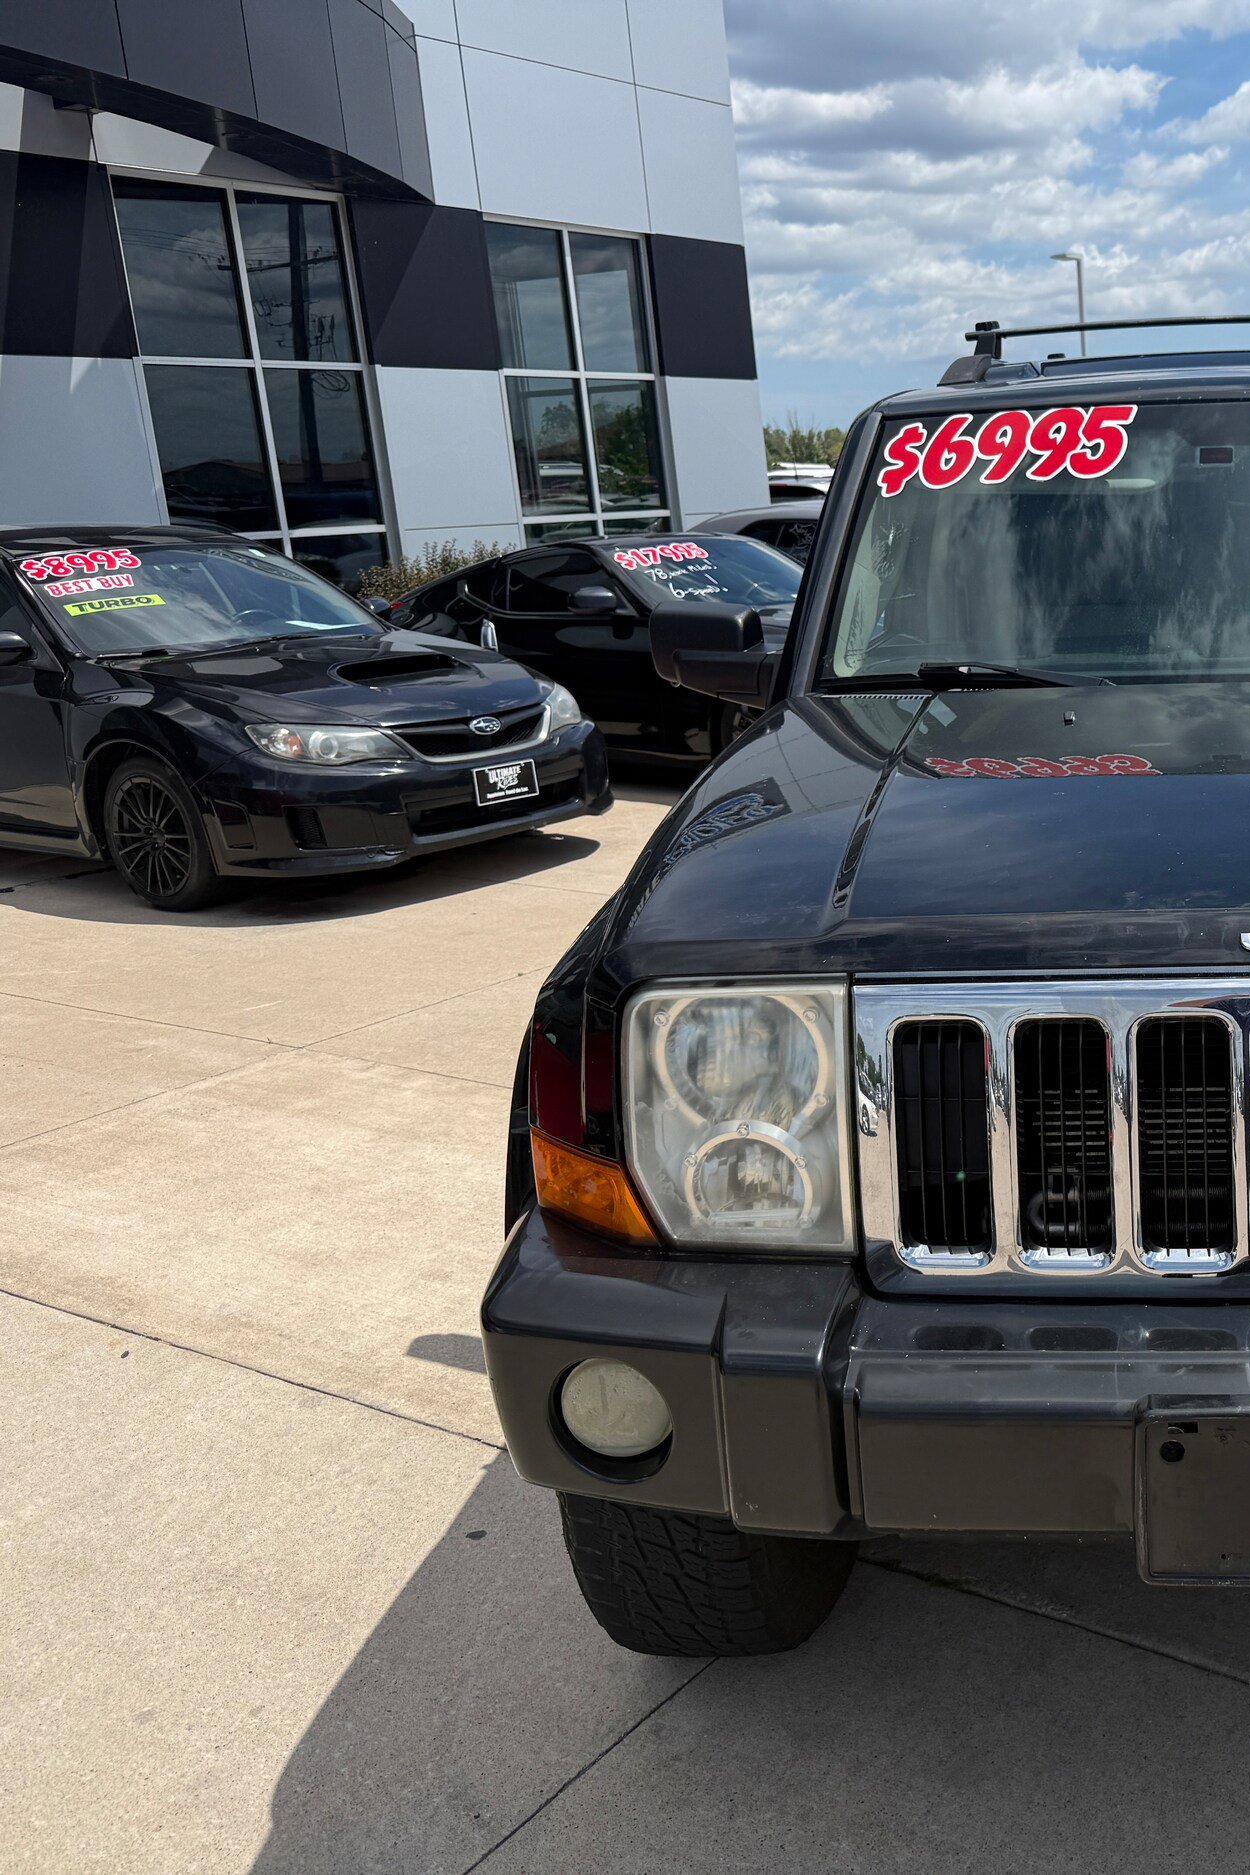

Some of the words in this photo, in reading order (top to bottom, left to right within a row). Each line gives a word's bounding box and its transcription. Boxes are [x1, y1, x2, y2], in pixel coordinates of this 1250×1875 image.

[877, 404, 1138, 497] $6995
[20, 548, 141, 580] $8995
[614, 542, 709, 570] $17995
[45, 578, 93, 597] BEST
[95, 574, 134, 591] BUY
[71, 596, 155, 612] TURBO
